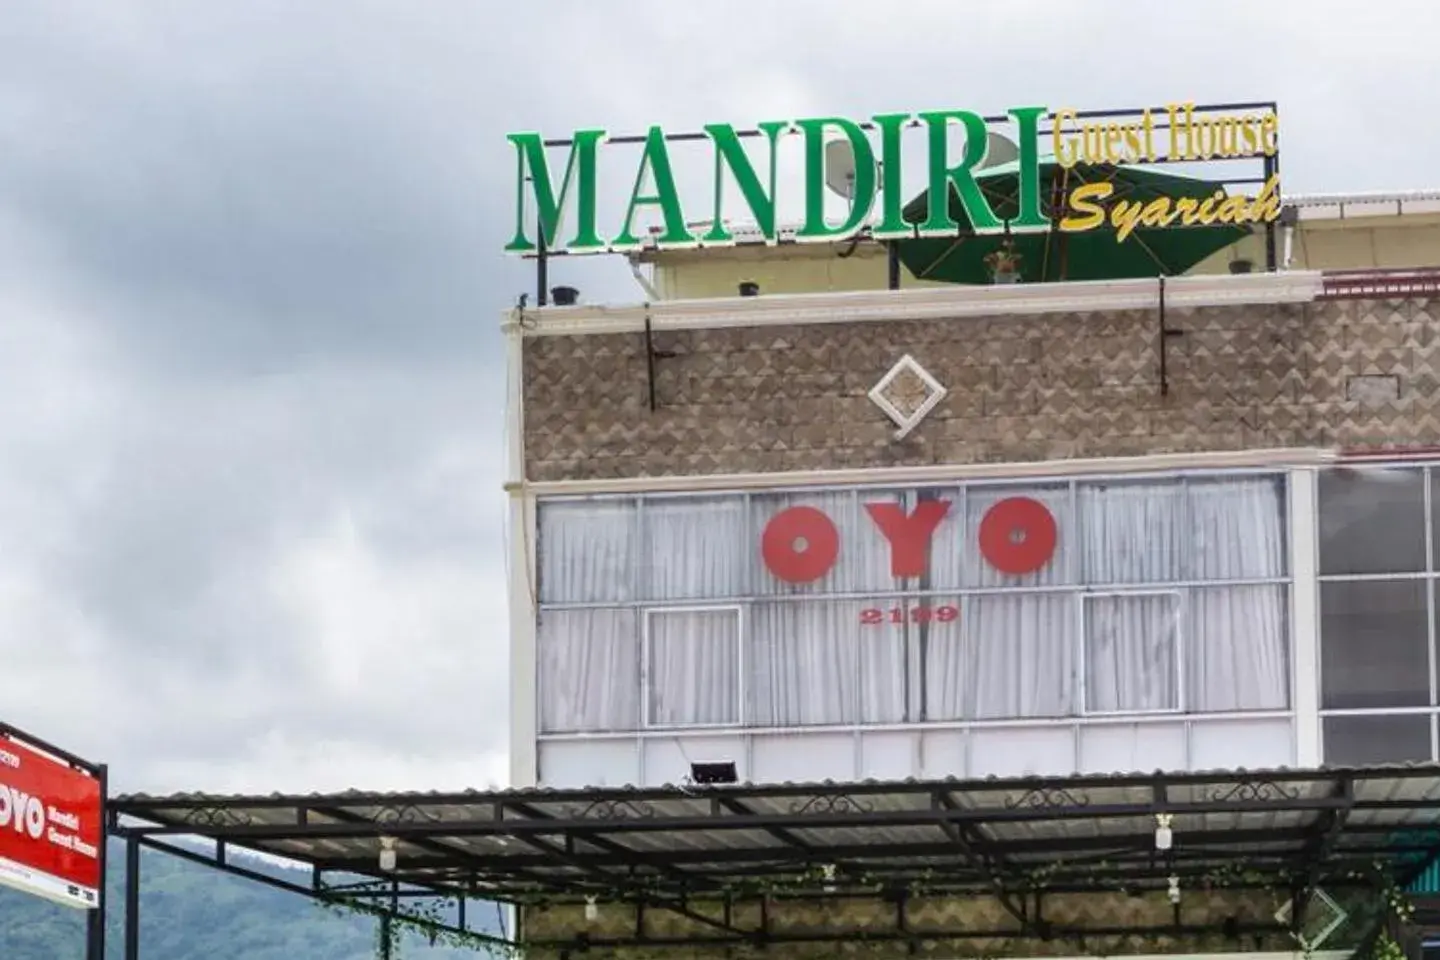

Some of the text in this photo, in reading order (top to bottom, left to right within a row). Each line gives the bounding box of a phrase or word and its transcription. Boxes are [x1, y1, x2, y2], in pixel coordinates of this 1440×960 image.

[504, 101, 1278, 251] MANDIRI Guest House
[1059, 173, 1281, 243] Syariah
[762, 497, 1057, 582] OYO
[0, 784, 45, 839] OYO
